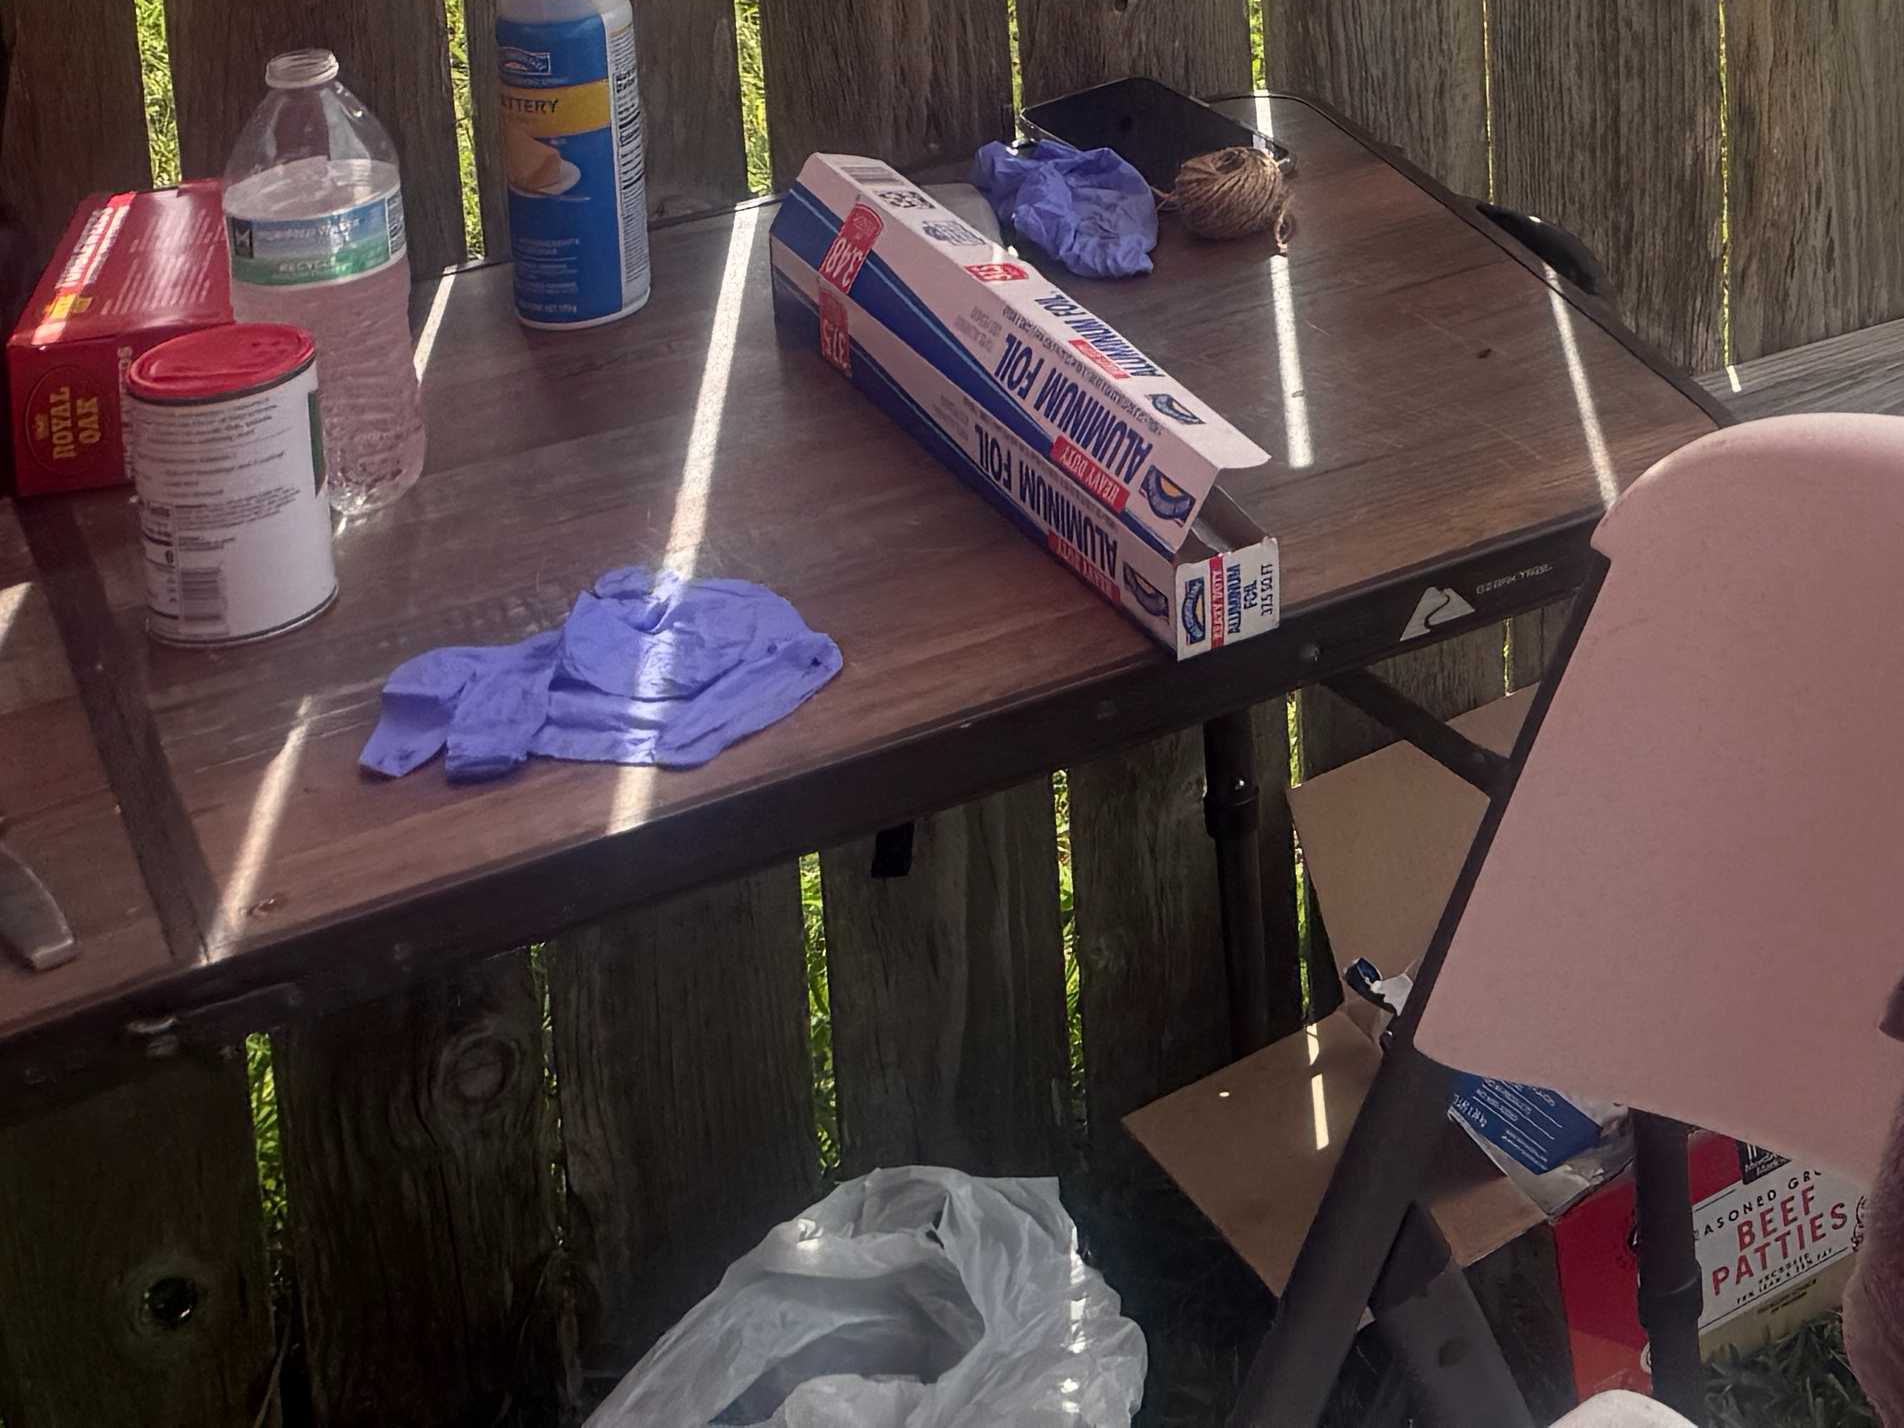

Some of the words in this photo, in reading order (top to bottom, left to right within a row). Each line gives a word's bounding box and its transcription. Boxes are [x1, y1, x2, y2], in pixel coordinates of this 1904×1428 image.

[1033, 293, 1087, 325] FOIL
[994, 332, 1045, 401] FOIL
[1064, 316, 1166, 378] ALUMINUM
[50, 386, 76, 460] ROYAL
[76, 396, 101, 445] OAK
[1033, 367, 1153, 484] ALUMINUM
[975, 424, 1012, 491] FOIL
[1062, 447, 1088, 478] DUTY
[1086, 468, 1120, 505] HEAVY
[1019, 459, 1118, 578] ALUMINUM
[1226, 564, 1242, 634] ALUMINUM
[1243, 579, 1258, 611] FOIL
[1712, 1202, 1848, 1297] PATTIES
[1737, 1185, 1815, 1253] BEEF
